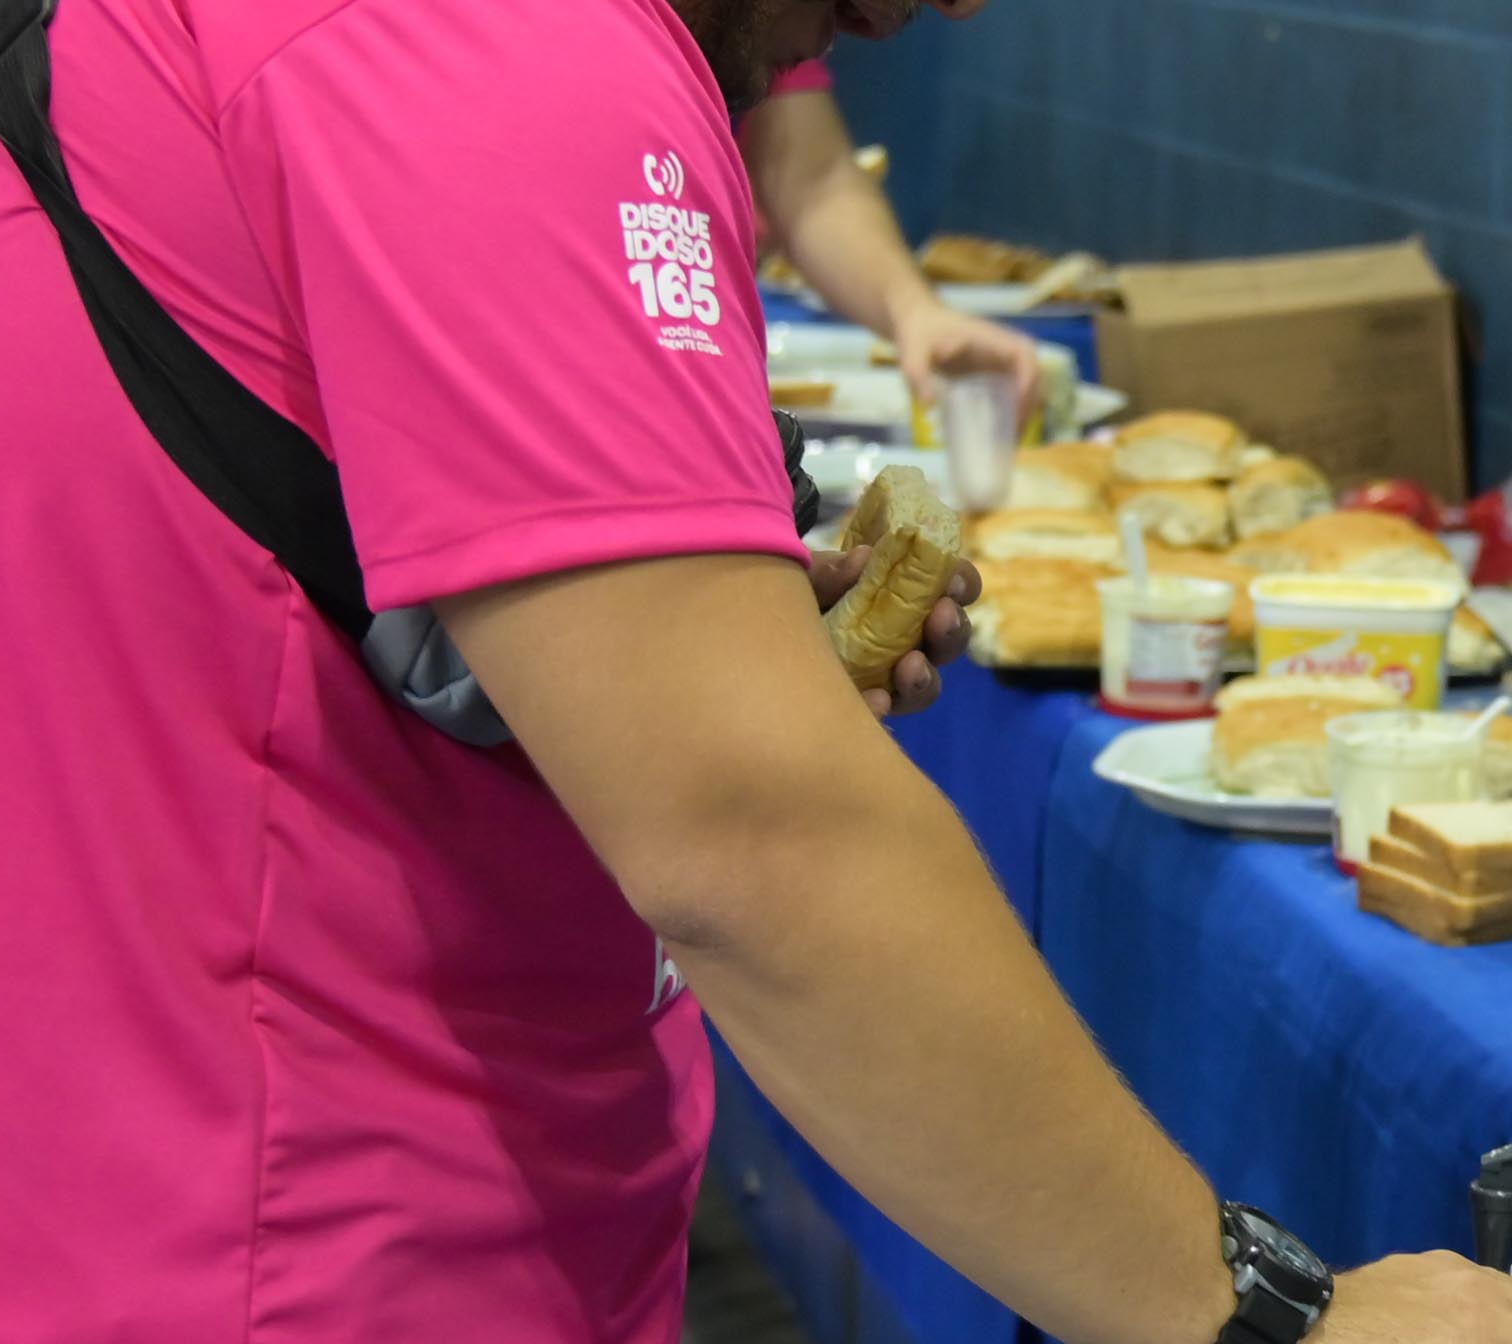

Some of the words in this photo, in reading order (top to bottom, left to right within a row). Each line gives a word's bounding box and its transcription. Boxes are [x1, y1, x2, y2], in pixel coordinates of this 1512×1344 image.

[619, 202, 711, 240] DISQUE
[624, 230, 714, 270] IDOSO
[628, 262, 720, 326] 165
